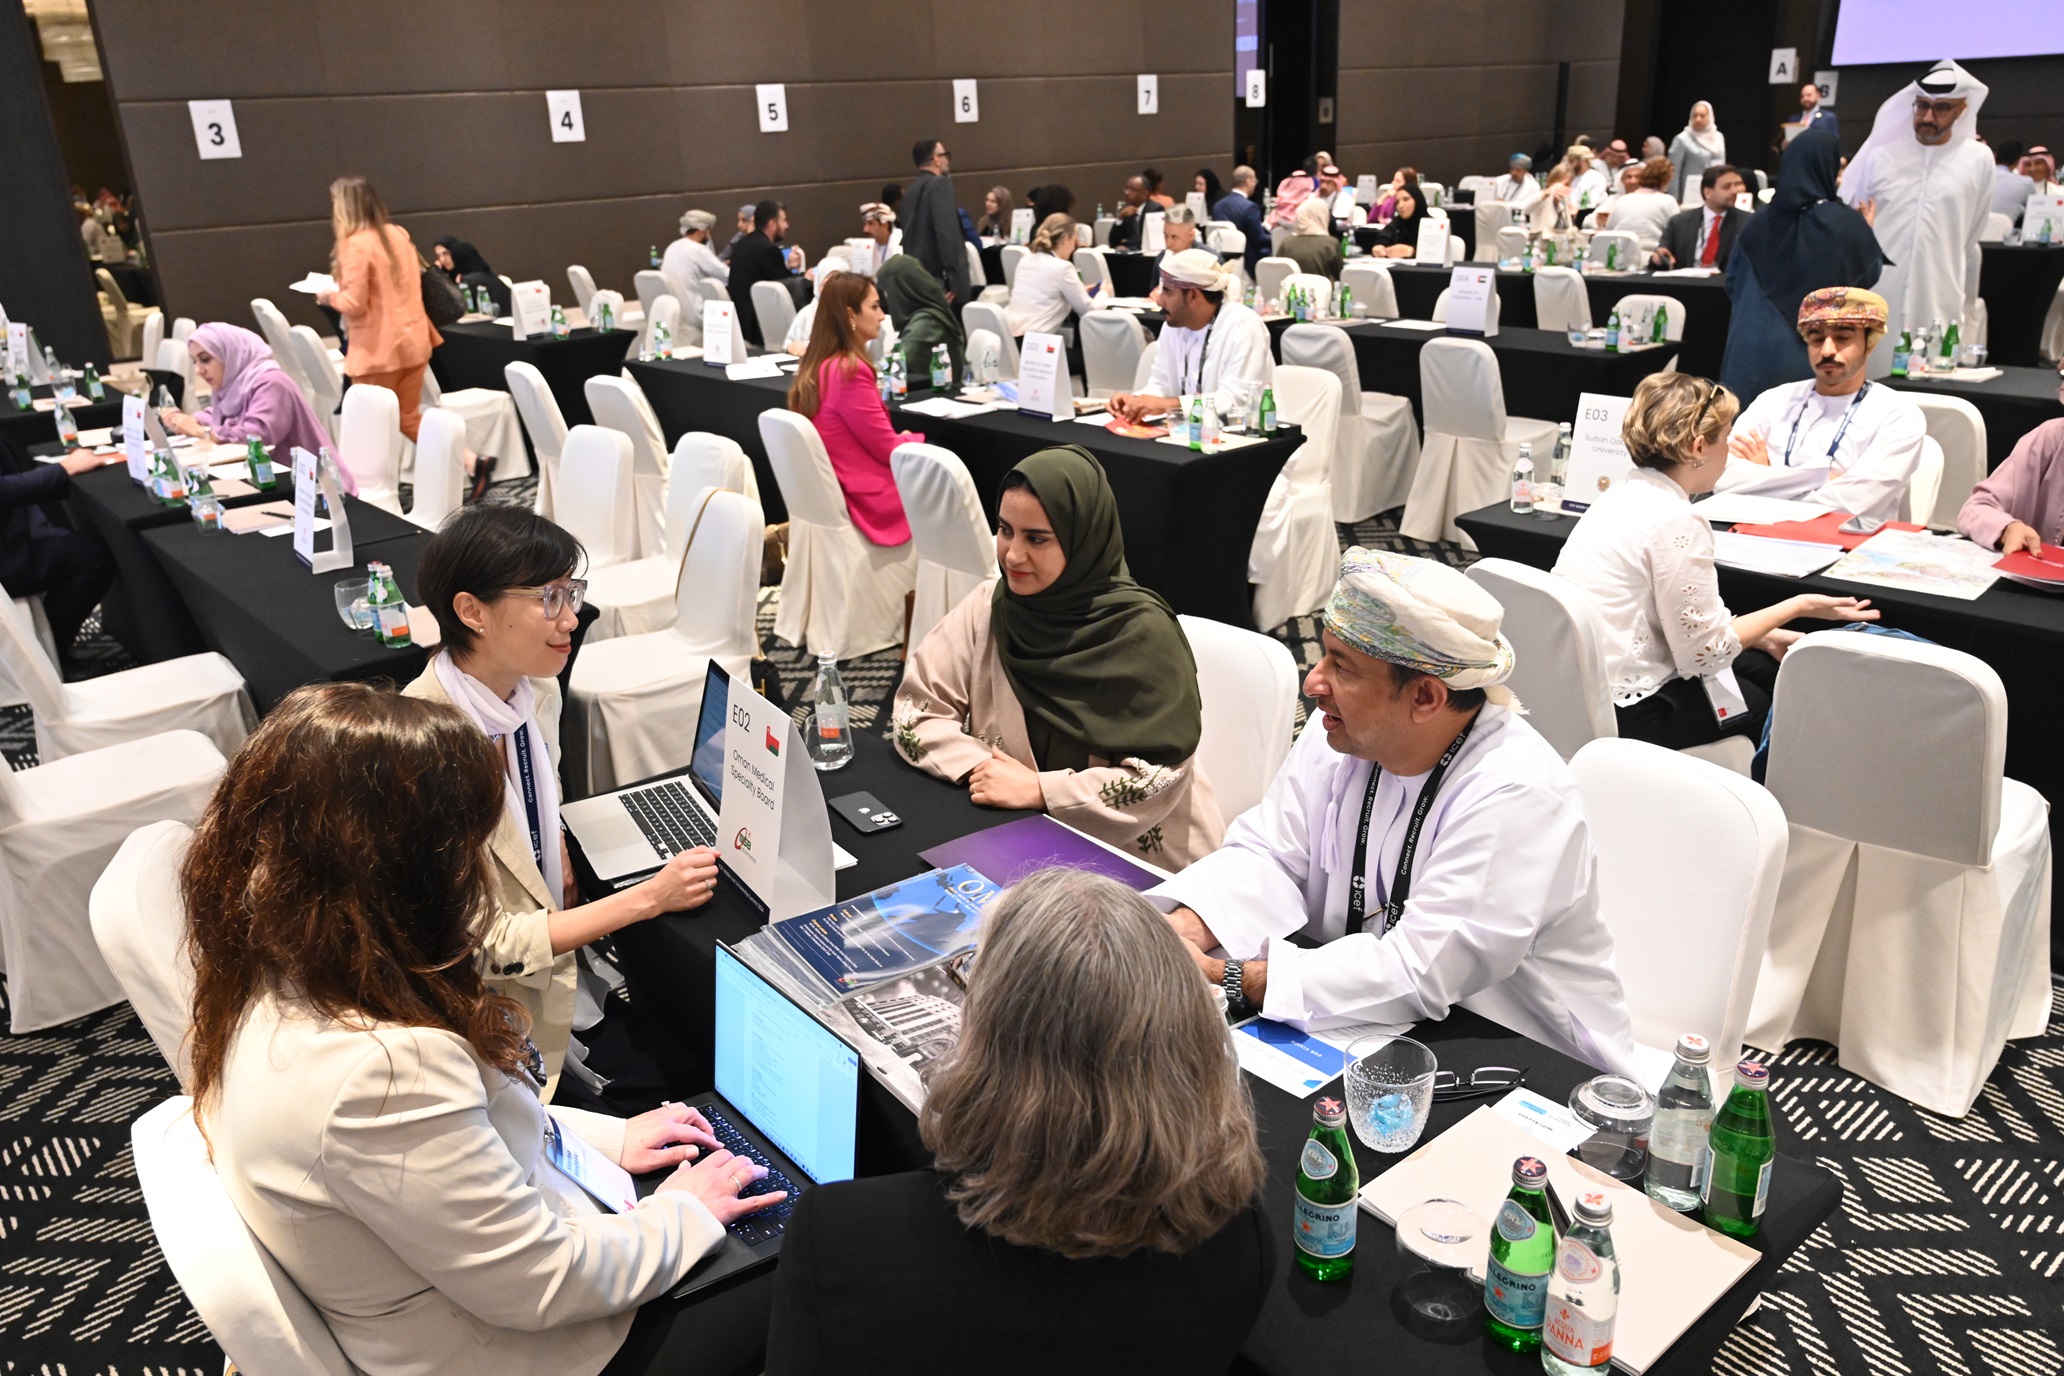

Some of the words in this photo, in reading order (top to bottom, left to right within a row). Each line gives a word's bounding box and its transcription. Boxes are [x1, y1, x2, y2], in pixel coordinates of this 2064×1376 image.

[1776, 61, 1787, 76] A
[1144, 90, 1151, 106] 7
[1252, 84, 1258, 99] 8
[768, 103, 778, 121] 5
[962, 96, 970, 113] 6
[561, 111, 573, 130] 4
[208, 122, 225, 146] 3
[1585, 408, 1608, 422] E03
[1584, 434, 1608, 443] Sultan
[1592, 445, 1627, 458] University
[733, 704, 750, 733] E02
[522, 748, 530, 774] Recruit.
[733, 750, 751, 772] Oman
[752, 765, 775, 792] Medical
[525, 774, 534, 803] Connect.
[730, 764, 756, 798] Specialty
[757, 788, 775, 811] Board
[1364, 798, 1375, 825] Recruit.
[1360, 825, 1369, 846] Grow.
[1401, 843, 1413, 875] Connect.
[1409, 817, 1422, 844] Recruit.
[1418, 795, 1429, 816] Grow.
[1353, 889, 1363, 912] icef
[1390, 902, 1399, 928] icef
[1290, 1040, 1310, 1052] VISION
[1310, 1050, 1323, 1058] OUR
[1546, 1315, 1584, 1350] PANNA
[1554, 1317, 1575, 1333] ACQUA
